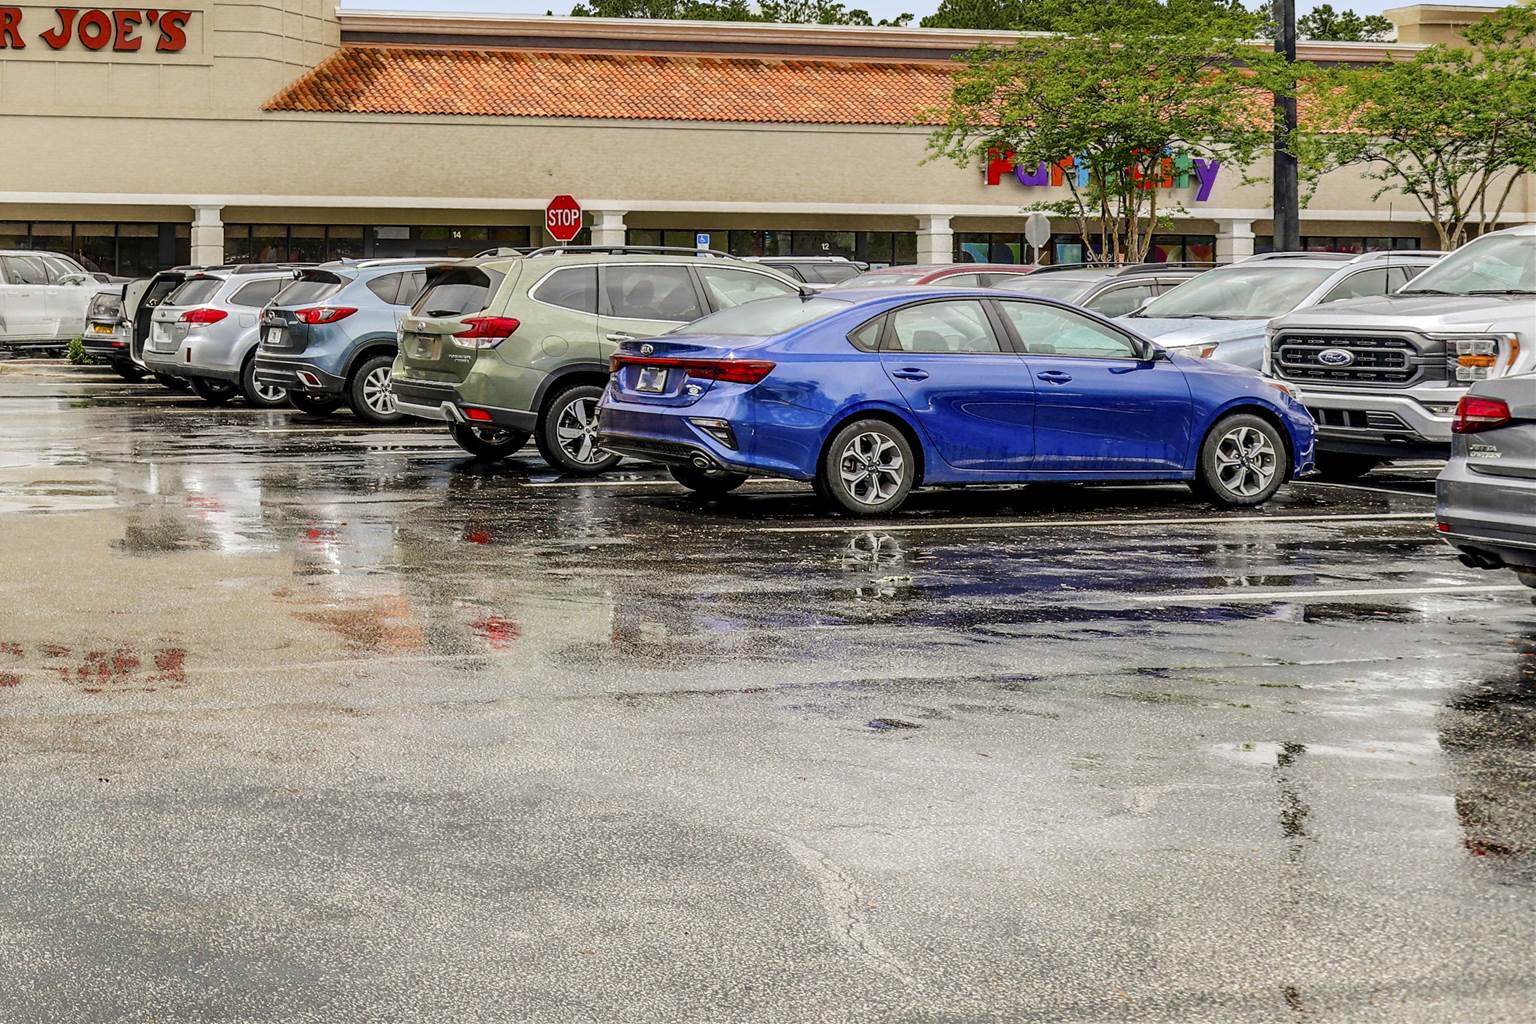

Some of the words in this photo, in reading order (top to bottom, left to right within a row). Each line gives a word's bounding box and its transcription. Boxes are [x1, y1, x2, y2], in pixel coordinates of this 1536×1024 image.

[39, 7, 192, 51] JOE'S
[548, 208, 580, 226] STOP
[452, 231, 462, 239] 14
[821, 242, 830, 251] 12
